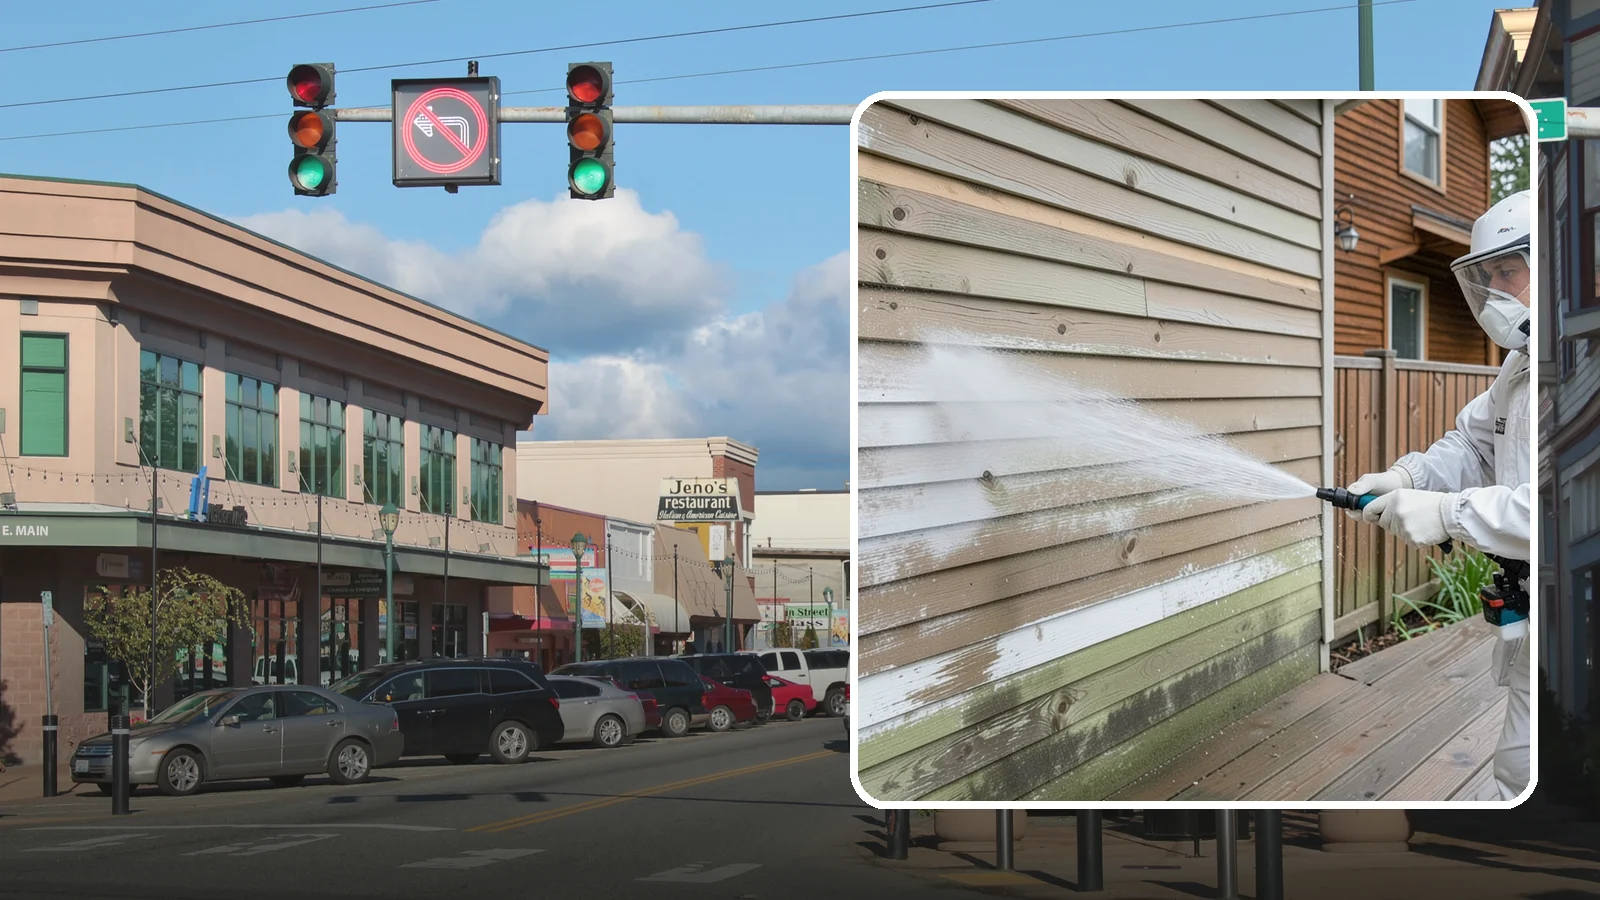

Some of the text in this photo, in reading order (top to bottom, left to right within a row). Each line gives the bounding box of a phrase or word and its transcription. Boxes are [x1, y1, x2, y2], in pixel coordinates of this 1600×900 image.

[670, 480, 728, 494] Jeno's
[665, 496, 730, 508] restaurant
[658, 510, 680, 519] Italian
[686, 510, 714, 519] American
[715, 510, 738, 519] Cuisine
[2, 525, 48, 536] E. MAIN
[797, 608, 828, 616] Street
